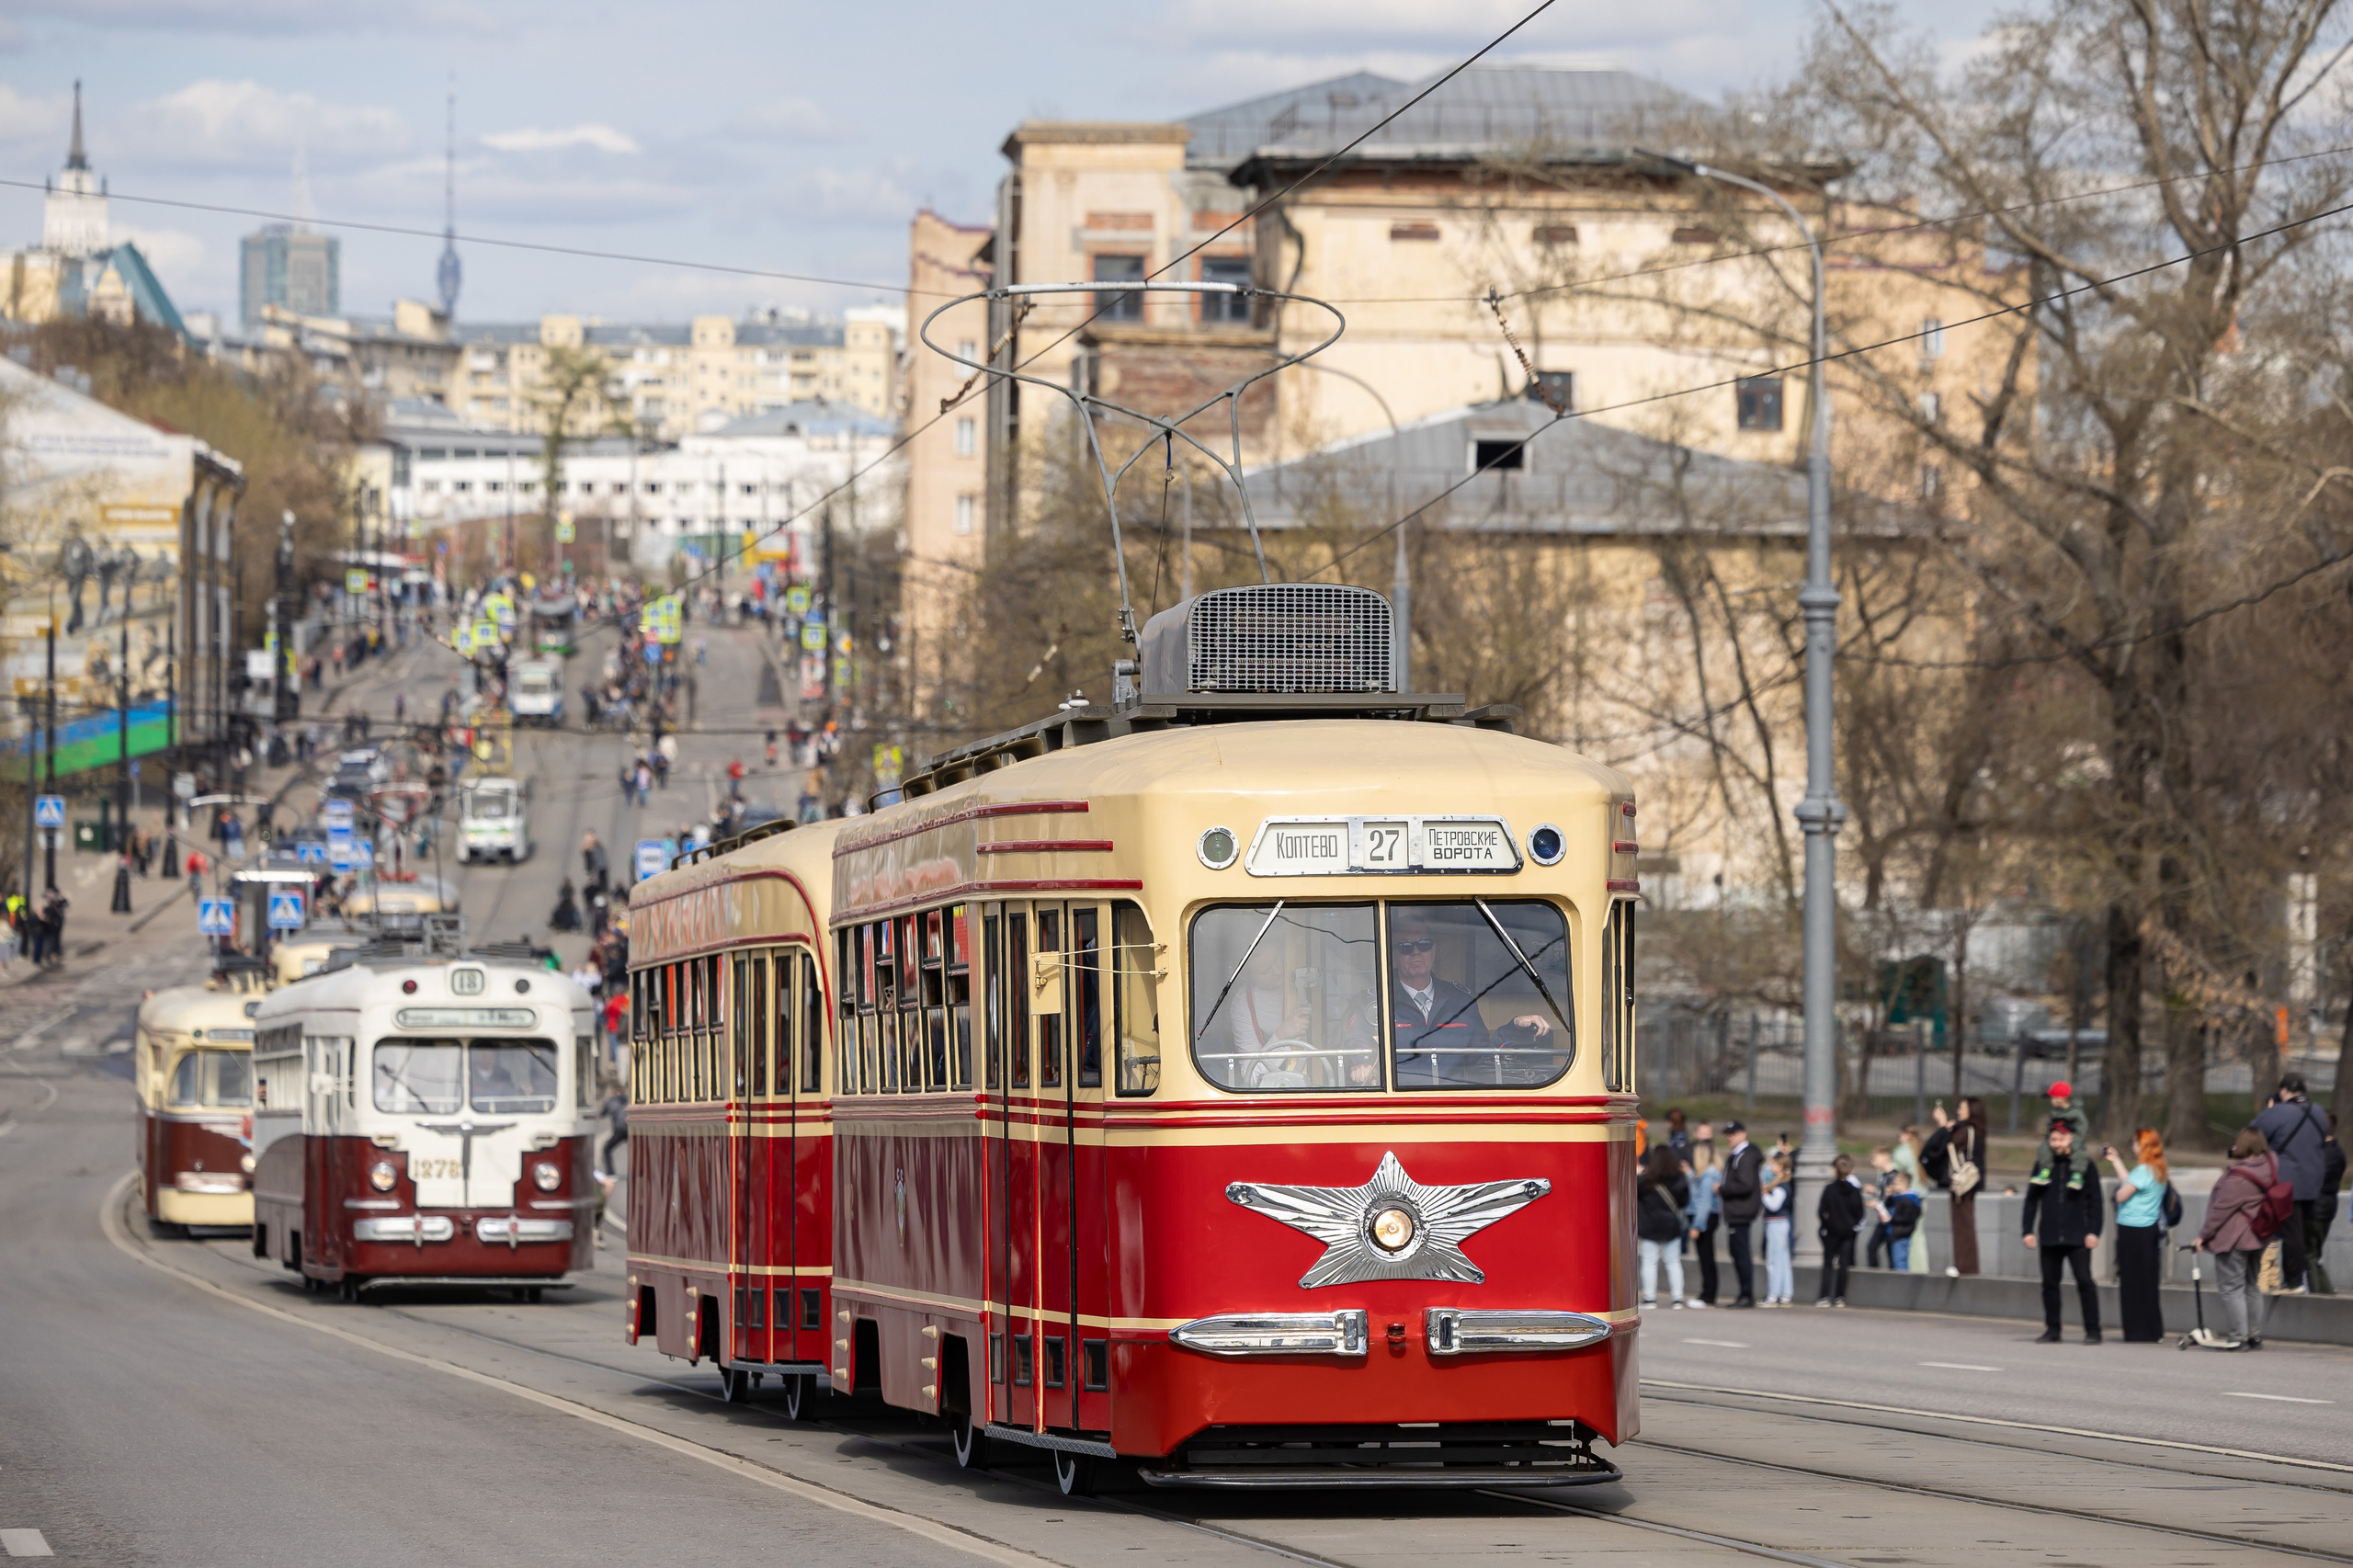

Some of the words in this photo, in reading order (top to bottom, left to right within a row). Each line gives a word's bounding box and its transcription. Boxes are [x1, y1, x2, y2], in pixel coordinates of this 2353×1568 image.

[1276, 832, 1338, 858] КОПТЕВО
[1370, 829, 1400, 861] 27
[1428, 828, 1498, 846] ПЕТРОВСКИЕ
[1433, 847, 1493, 859] ВОРОТА
